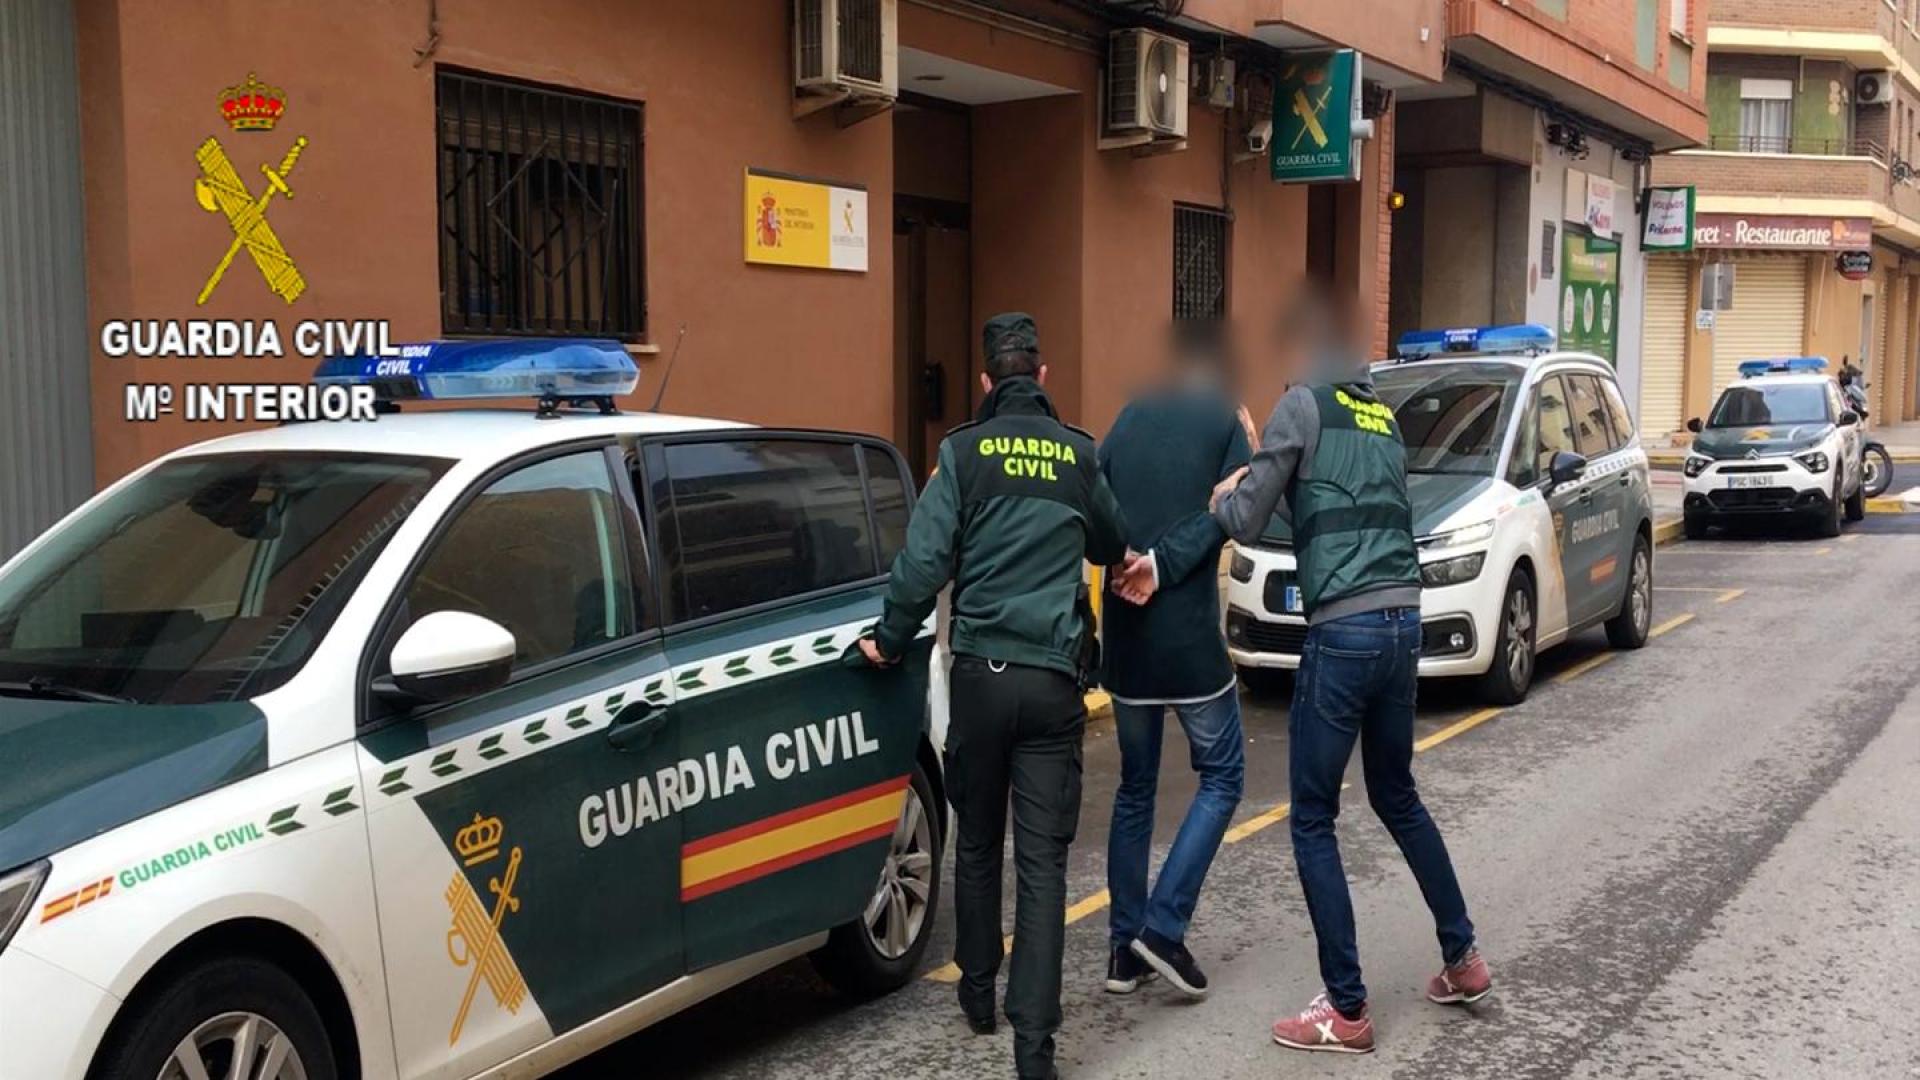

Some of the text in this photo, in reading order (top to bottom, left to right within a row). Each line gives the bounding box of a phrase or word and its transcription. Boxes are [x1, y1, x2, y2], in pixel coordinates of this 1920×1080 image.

[1276, 151, 1342, 166] GUARDIA CIVIL
[1693, 225, 1720, 243] cet
[1735, 219, 1831, 245] Restaurante
[375, 359, 411, 376] CIVIL
[1355, 411, 1393, 435] CIVIL
[979, 437, 1077, 465] GUARDIA
[1003, 456, 1058, 481] CIVIL
[578, 711, 879, 848] GUARDIA CIVIL
[118, 823, 264, 890] GUARDIA CIVIL
